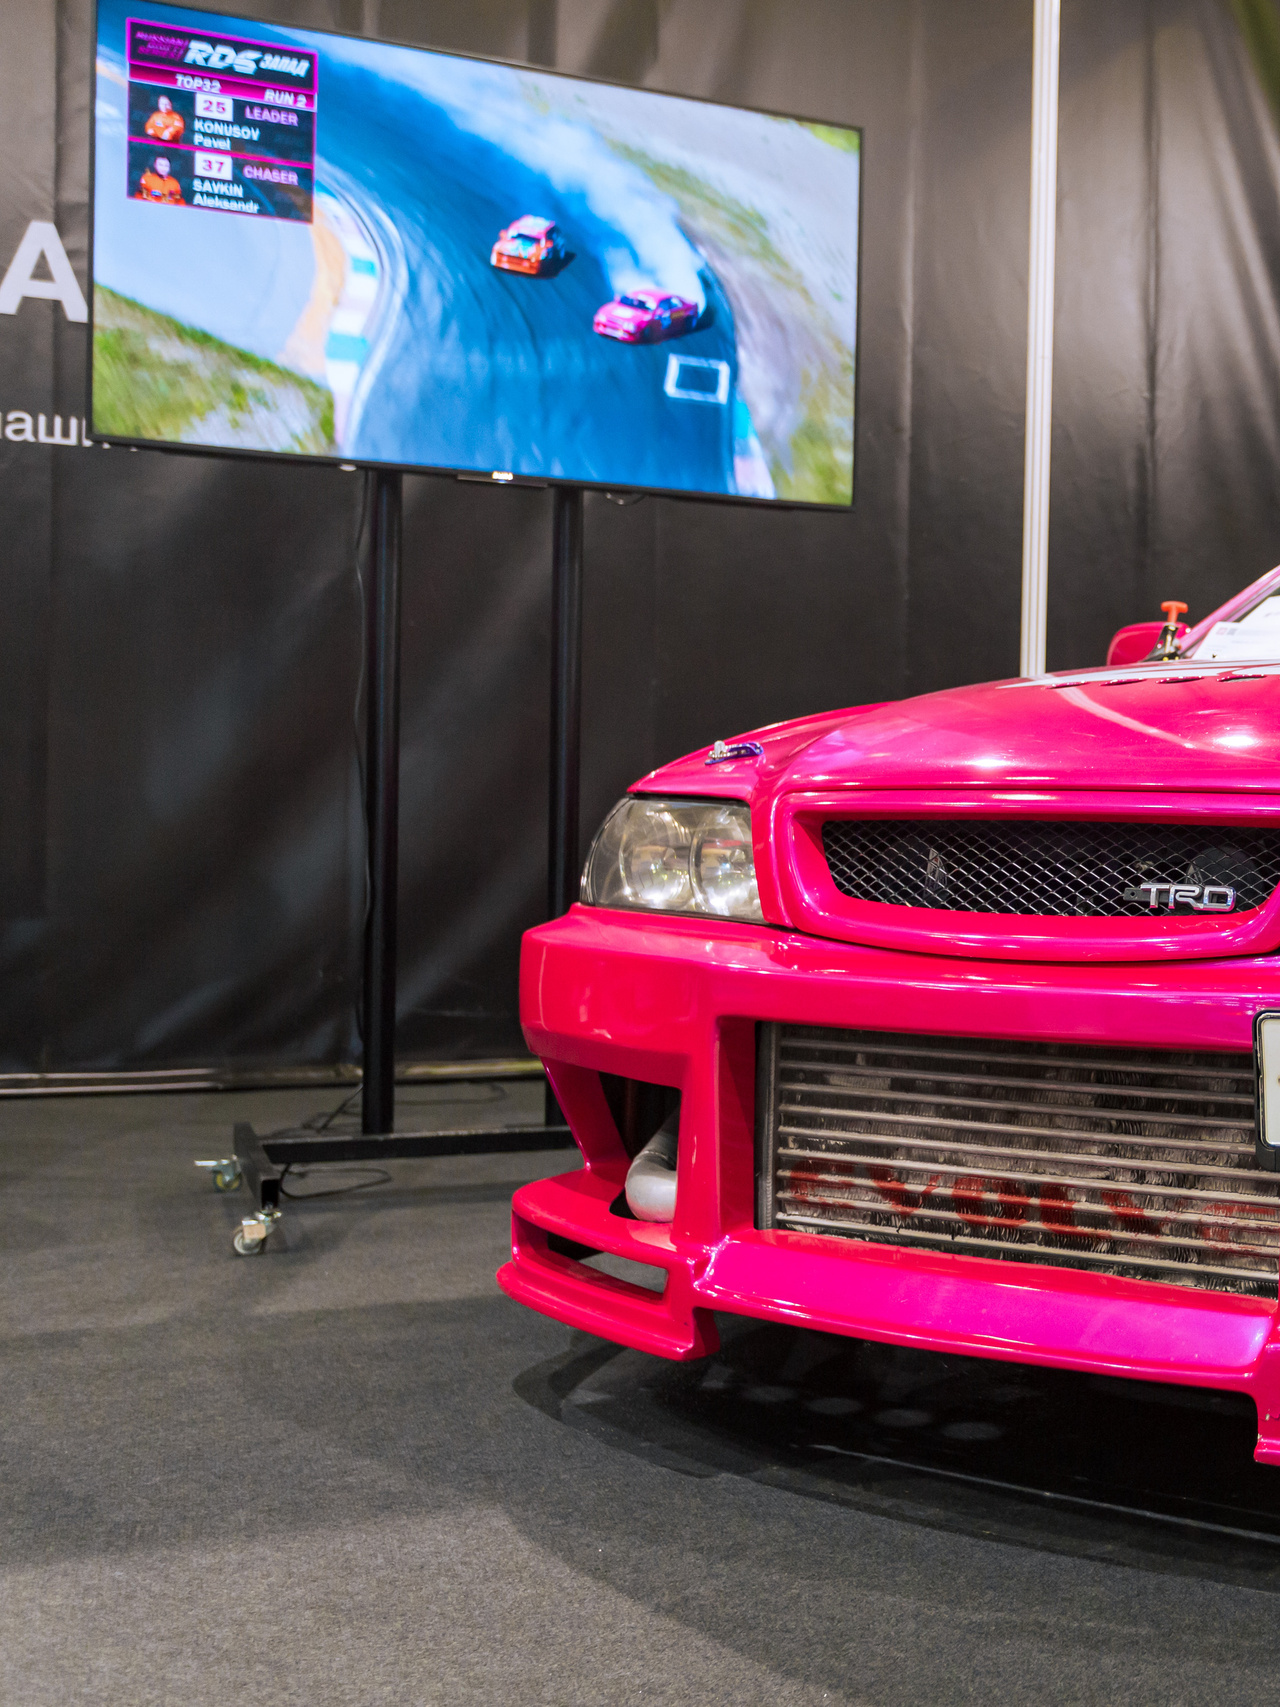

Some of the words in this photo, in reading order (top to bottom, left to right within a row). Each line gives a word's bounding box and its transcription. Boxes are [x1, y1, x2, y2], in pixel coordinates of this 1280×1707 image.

[184, 40, 262, 75] RDS
[259, 54, 311, 78] ЗАПАД
[176, 74, 221, 93] TOP32
[203, 100, 226, 113] 25
[264, 89, 295, 106] RUN
[244, 105, 299, 126] LEADER
[194, 119, 261, 141] KONUSOV
[194, 134, 232, 151] Pavel
[202, 159, 224, 173] 37
[243, 165, 299, 186] CHASER
[193, 179, 244, 198] SAVKIN
[193, 194, 260, 214] Aleksandr
[1140, 883, 1237, 912] TRD
